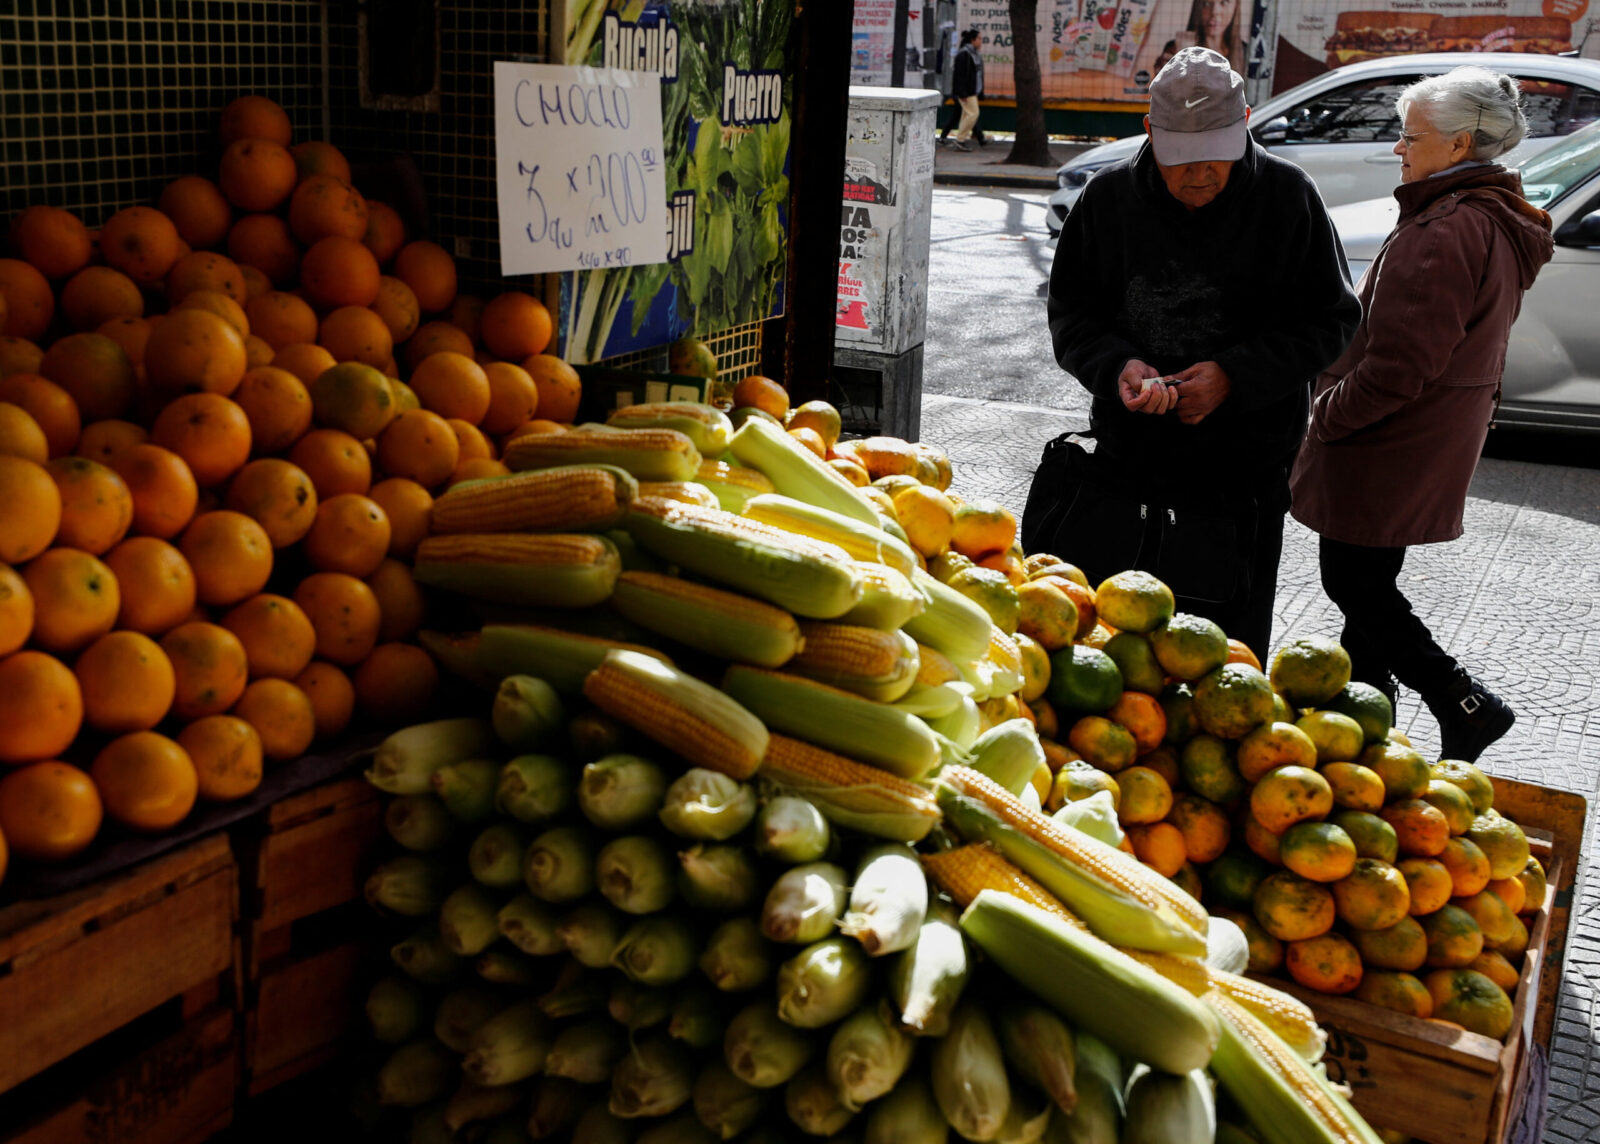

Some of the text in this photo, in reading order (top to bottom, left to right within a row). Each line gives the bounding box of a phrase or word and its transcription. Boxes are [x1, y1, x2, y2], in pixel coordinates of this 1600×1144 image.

[604, 16, 678, 79] Rucula
[1113, 8, 1131, 42] AdeS
[723, 65, 782, 122] Puerro
